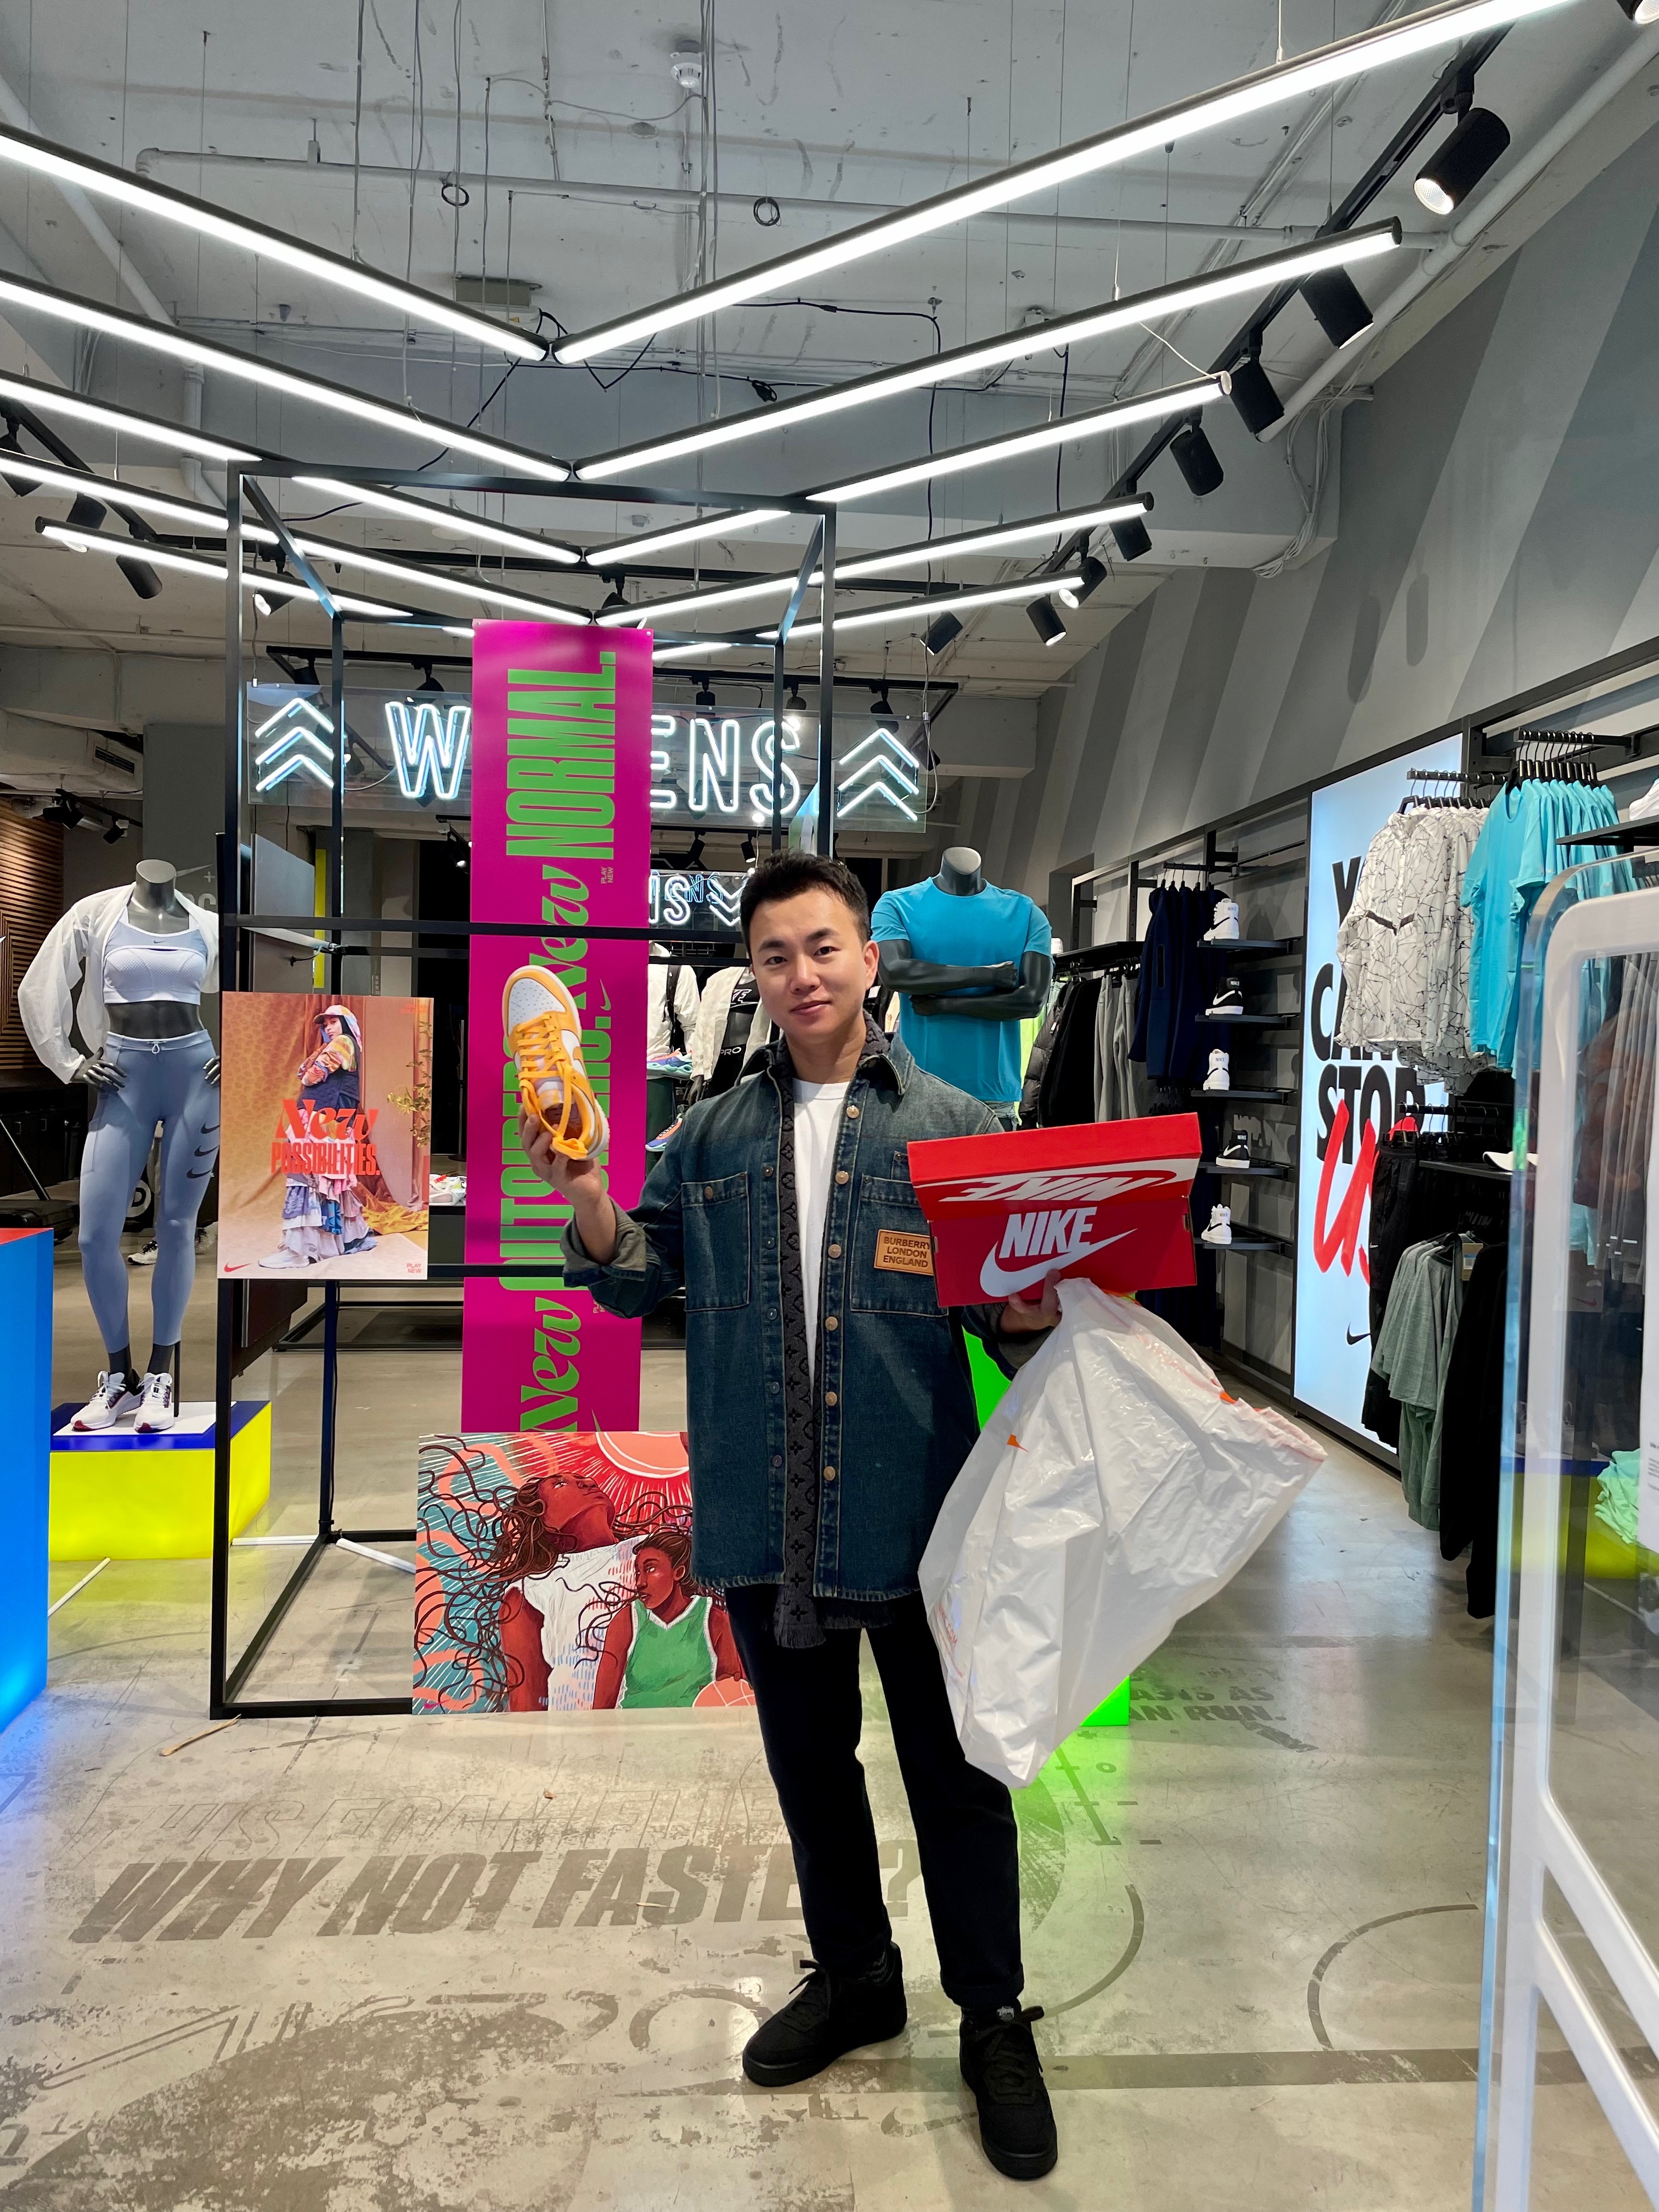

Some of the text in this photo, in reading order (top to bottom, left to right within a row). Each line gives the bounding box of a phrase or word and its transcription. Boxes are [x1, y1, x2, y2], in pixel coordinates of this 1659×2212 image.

[505, 651, 616, 860] NORMAL.
[275, 1099, 379, 1141] New
[270, 1142, 381, 1176] POSSIBILITIES.
[938, 1176, 1165, 1202] NIKE
[883, 1237, 930, 1250] BURBERRY
[998, 1206, 1098, 1259] NIKE
[883, 1255, 929, 1268] ENGLAND
[887, 1246, 928, 1259] LONDON
[520, 1296, 582, 1432] New
[1183, 1705, 1287, 1722] RUN.
[68, 1839, 924, 1944] WHY NOT FASTE?
